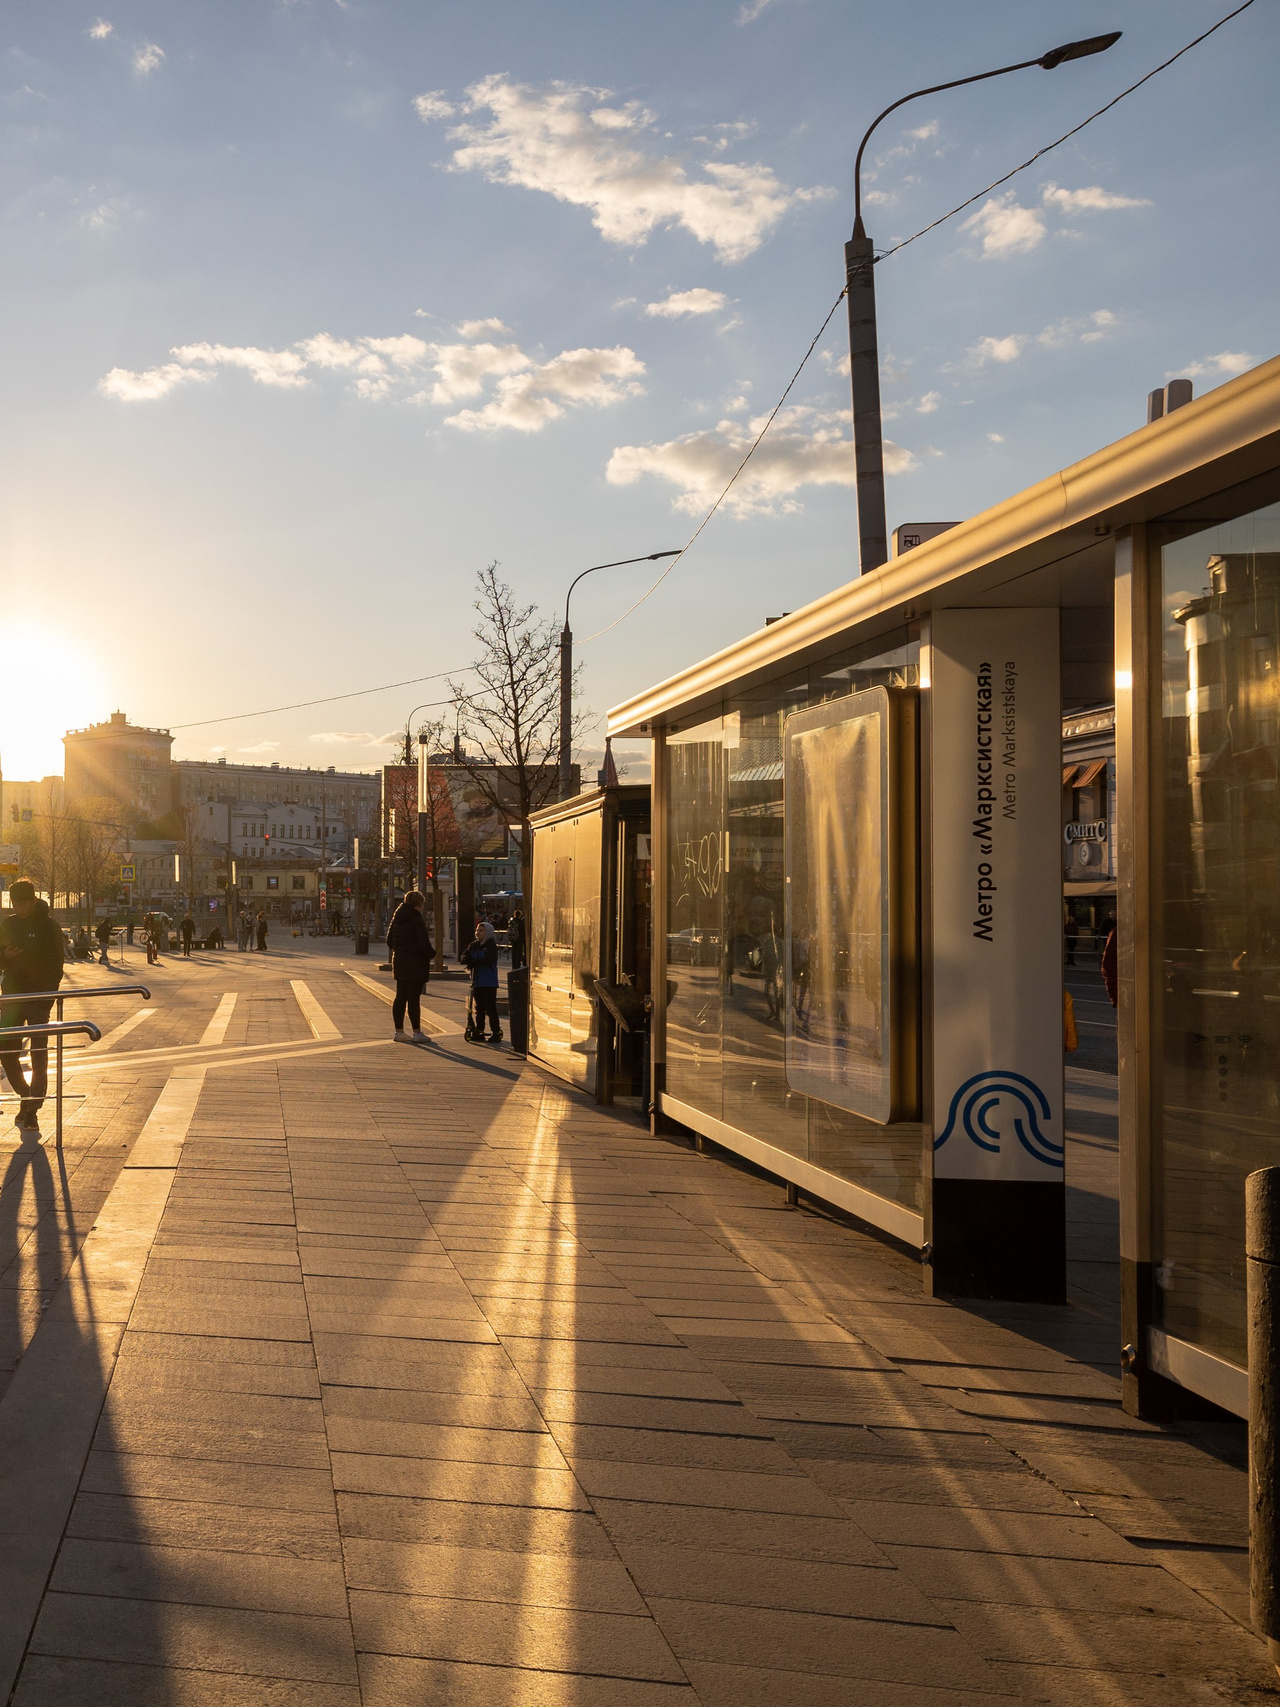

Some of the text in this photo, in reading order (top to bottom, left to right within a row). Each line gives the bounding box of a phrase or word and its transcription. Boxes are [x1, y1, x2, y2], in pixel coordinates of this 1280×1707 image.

[972, 661, 998, 943] Метро «Марксистская»
[1000, 660, 1019, 820] Metro Marksistskaya
[1064, 821, 1106, 845] СМИТС
